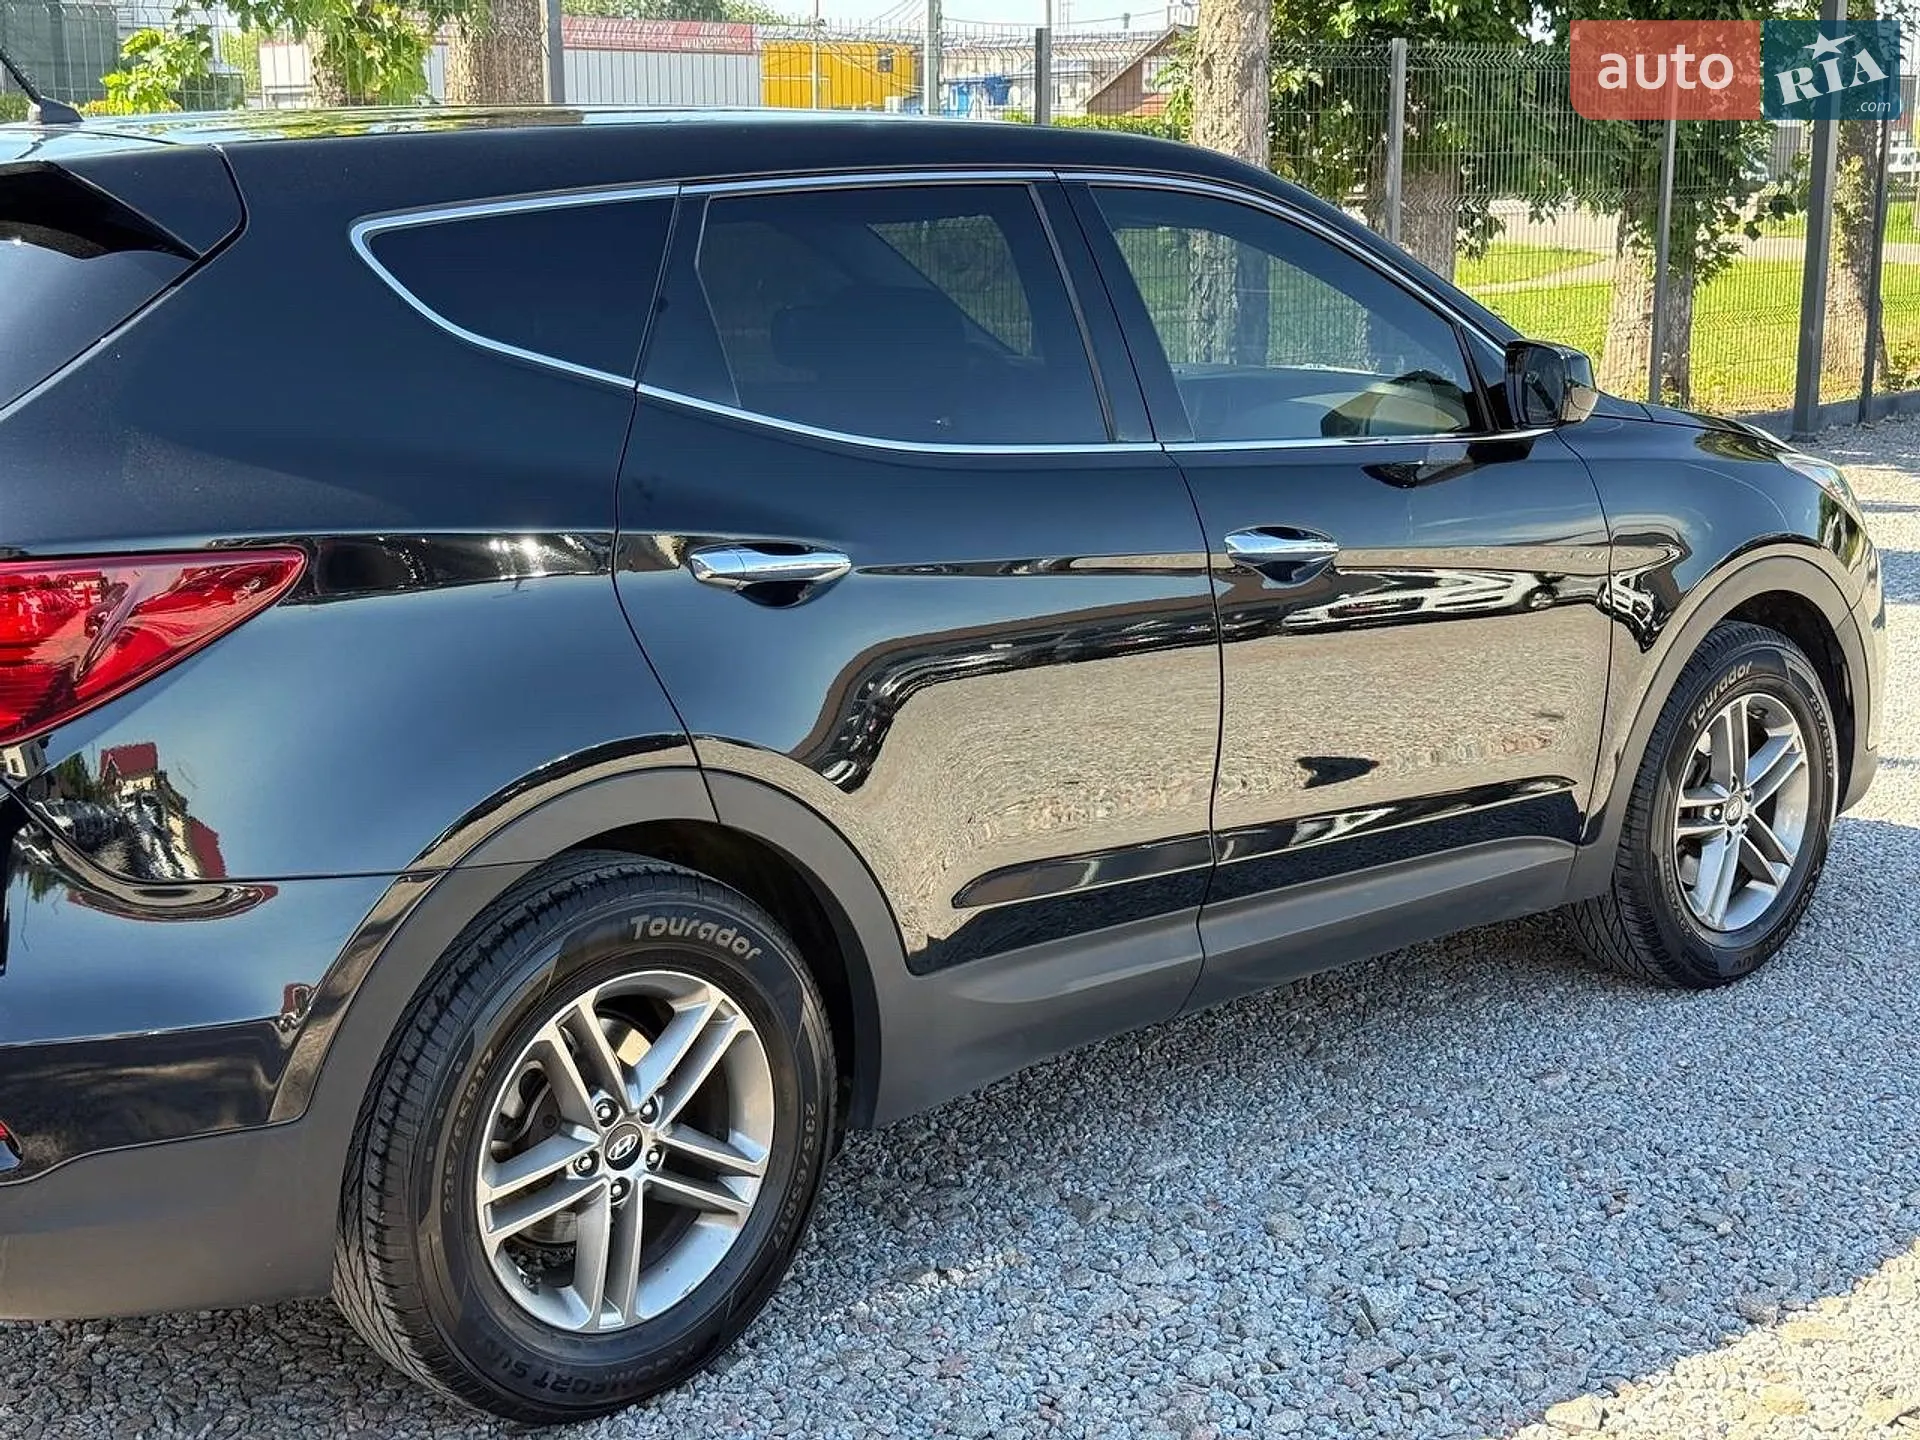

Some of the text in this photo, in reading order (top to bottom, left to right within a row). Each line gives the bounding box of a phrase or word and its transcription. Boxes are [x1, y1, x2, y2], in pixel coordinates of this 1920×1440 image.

[1688, 661, 1752, 730] Tourador
[630, 914, 763, 960] Tourador
[444, 1047, 494, 1213] 235/65R17
[772, 1102, 817, 1248] 235/65R17
